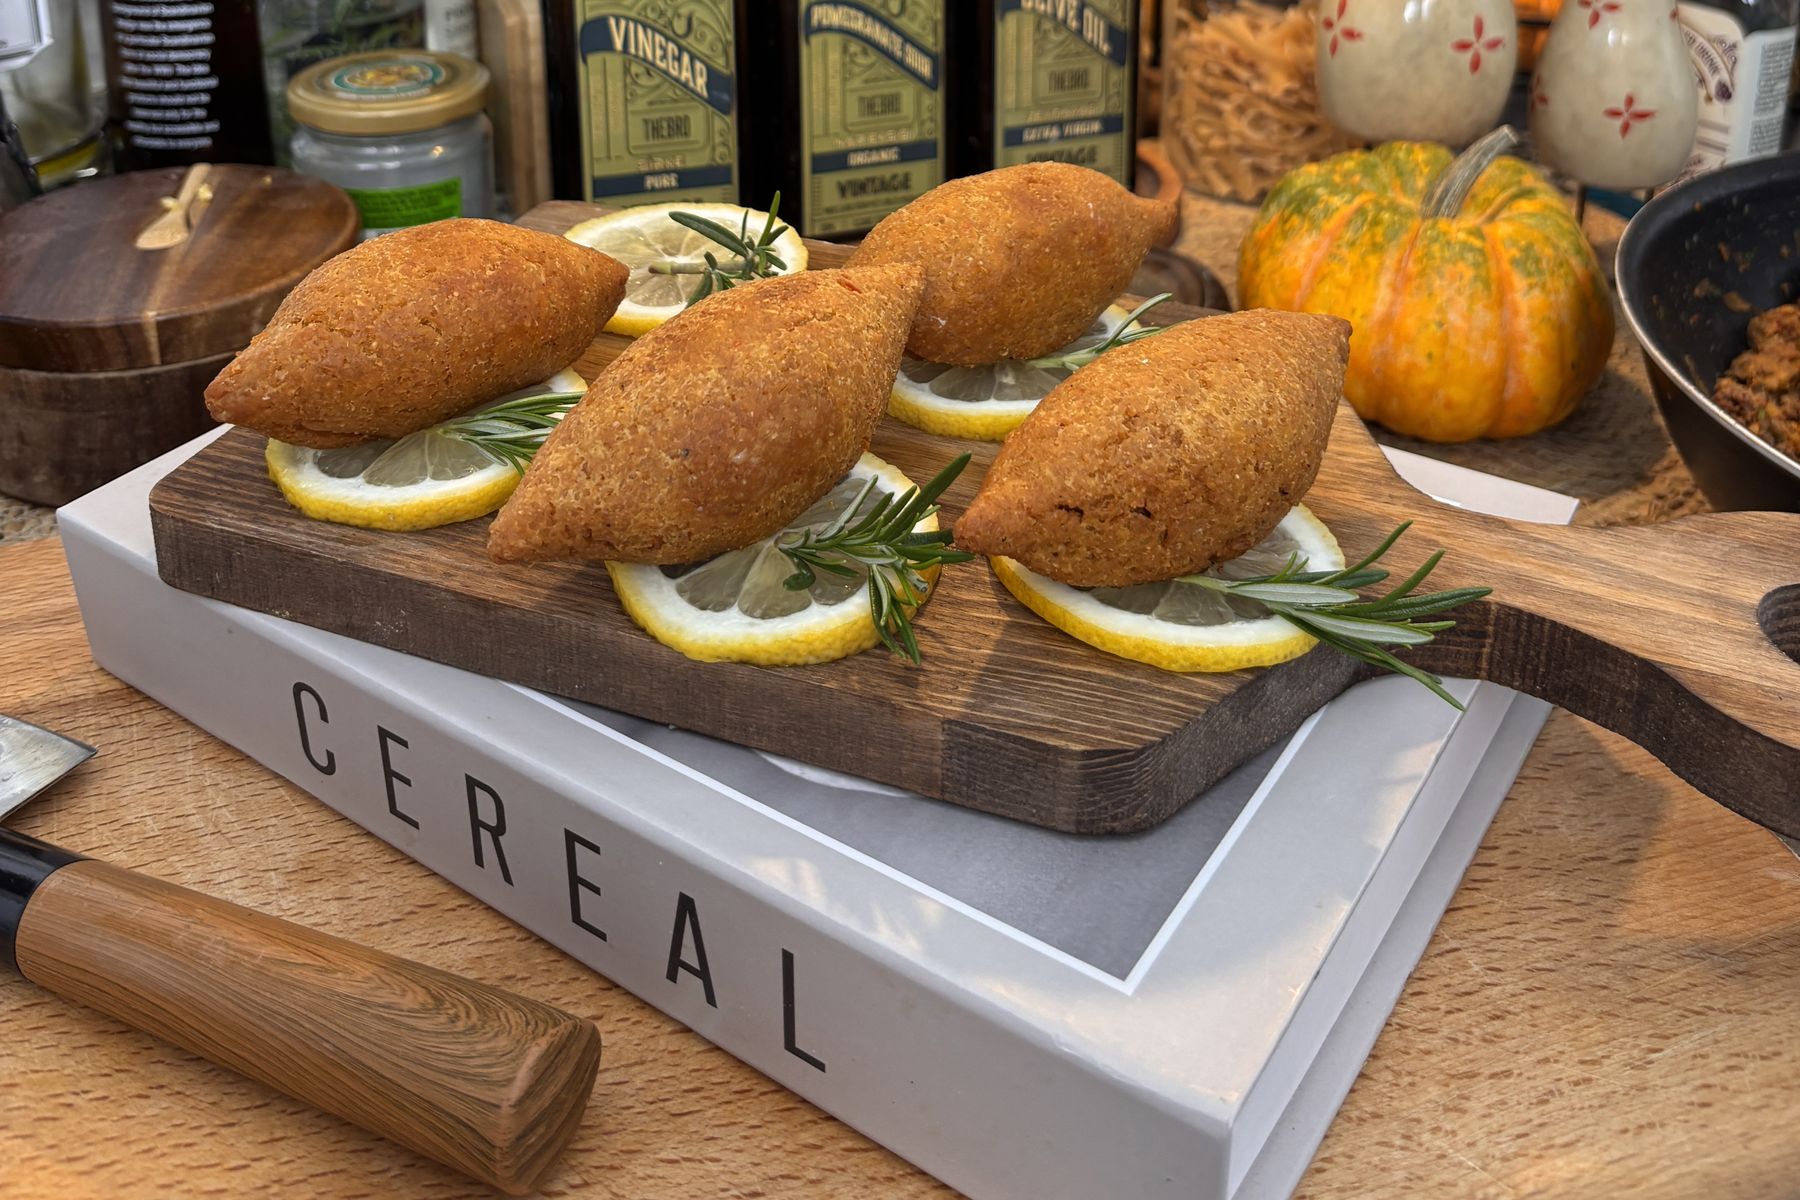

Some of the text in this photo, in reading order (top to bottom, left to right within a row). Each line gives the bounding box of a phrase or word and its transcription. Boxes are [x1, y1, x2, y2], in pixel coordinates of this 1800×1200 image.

[607, 15, 709, 99] VINEGAR
[1083, 4, 1113, 55] OIL
[837, 171, 911, 199] VINTAGE
[292, 681, 826, 1073] CEREAL
